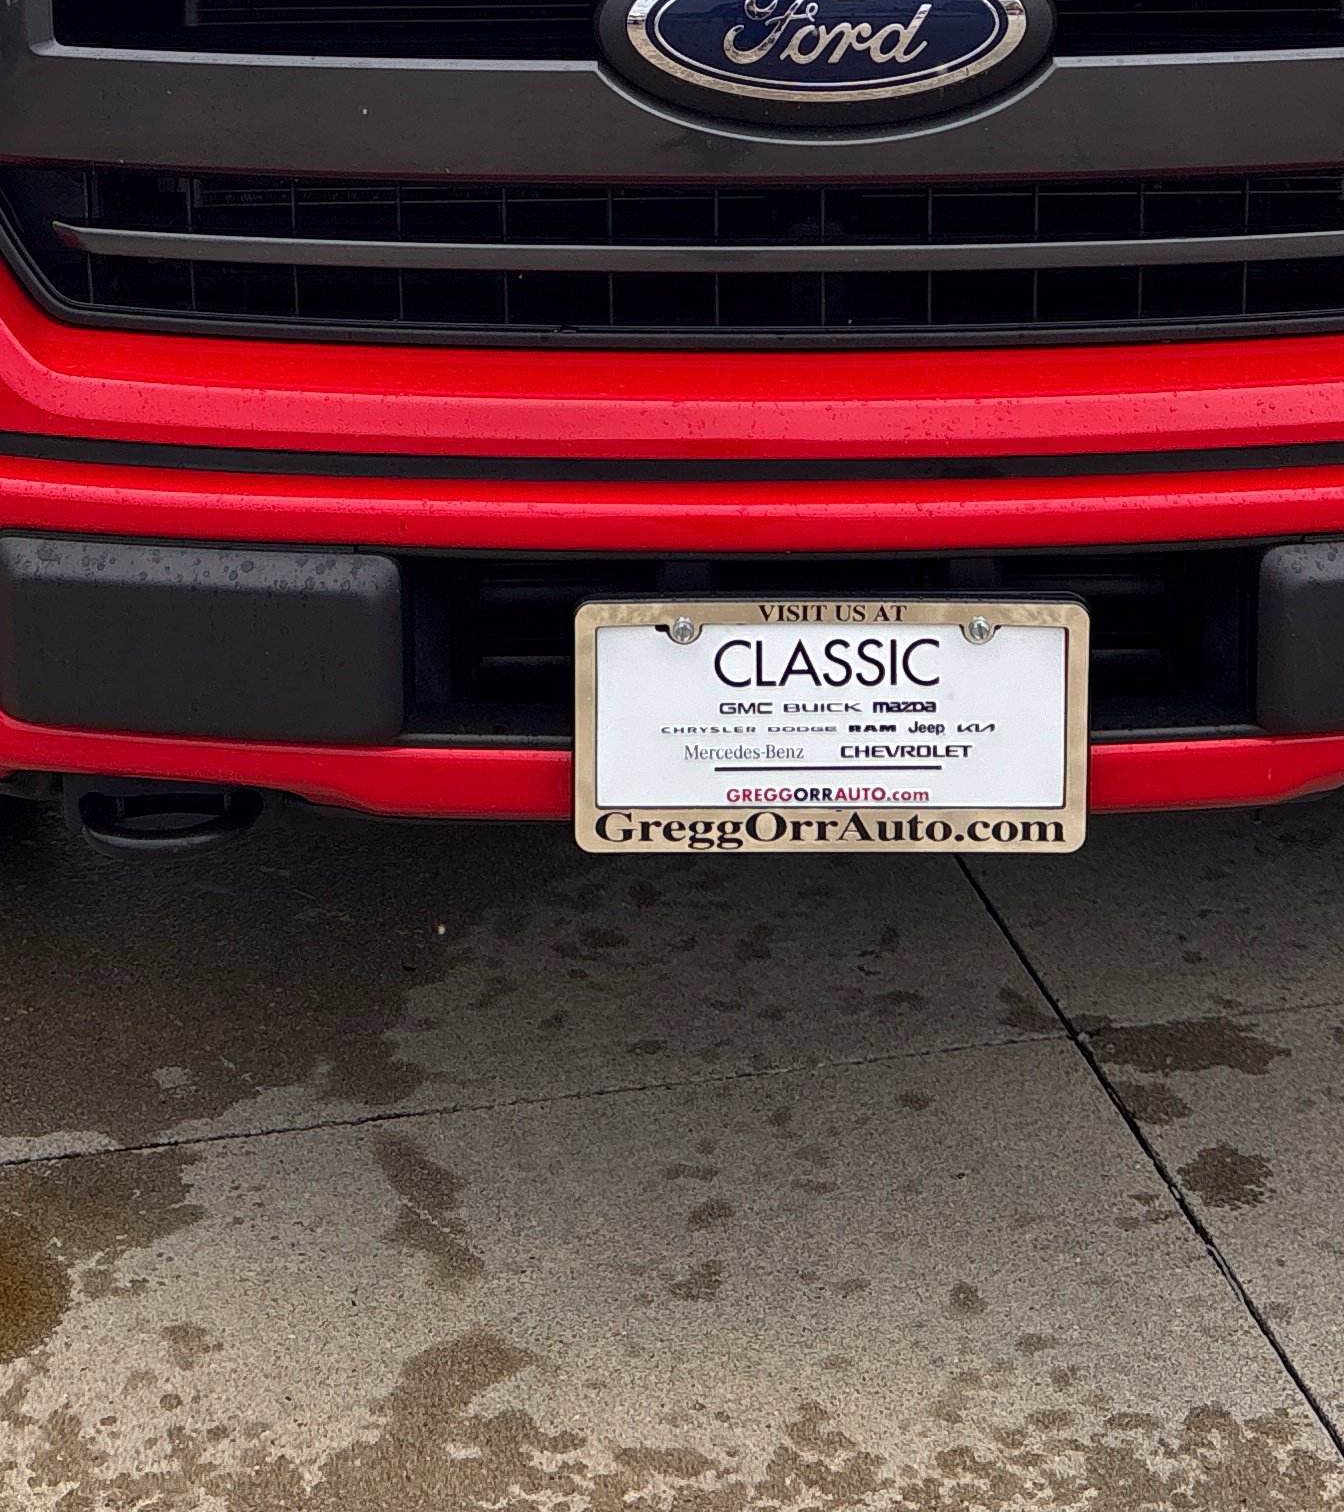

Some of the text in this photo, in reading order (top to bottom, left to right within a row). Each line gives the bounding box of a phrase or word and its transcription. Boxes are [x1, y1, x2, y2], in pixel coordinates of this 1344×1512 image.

[758, 605, 908, 623] VISIT US AT
[714, 639, 940, 688] CLASSIC
[719, 702, 773, 715] GMC
[783, 702, 863, 714] BUICK
[660, 726, 757, 734] CHRYSLER
[848, 724, 897, 733] RAM
[908, 721, 946, 735] Jeep
[684, 744, 973, 761] Mercedes-Benz CHEVROLET
[726, 787, 930, 803] GREGGORRAUTO.com
[595, 810, 1065, 850] GreggOrrAuto.com
